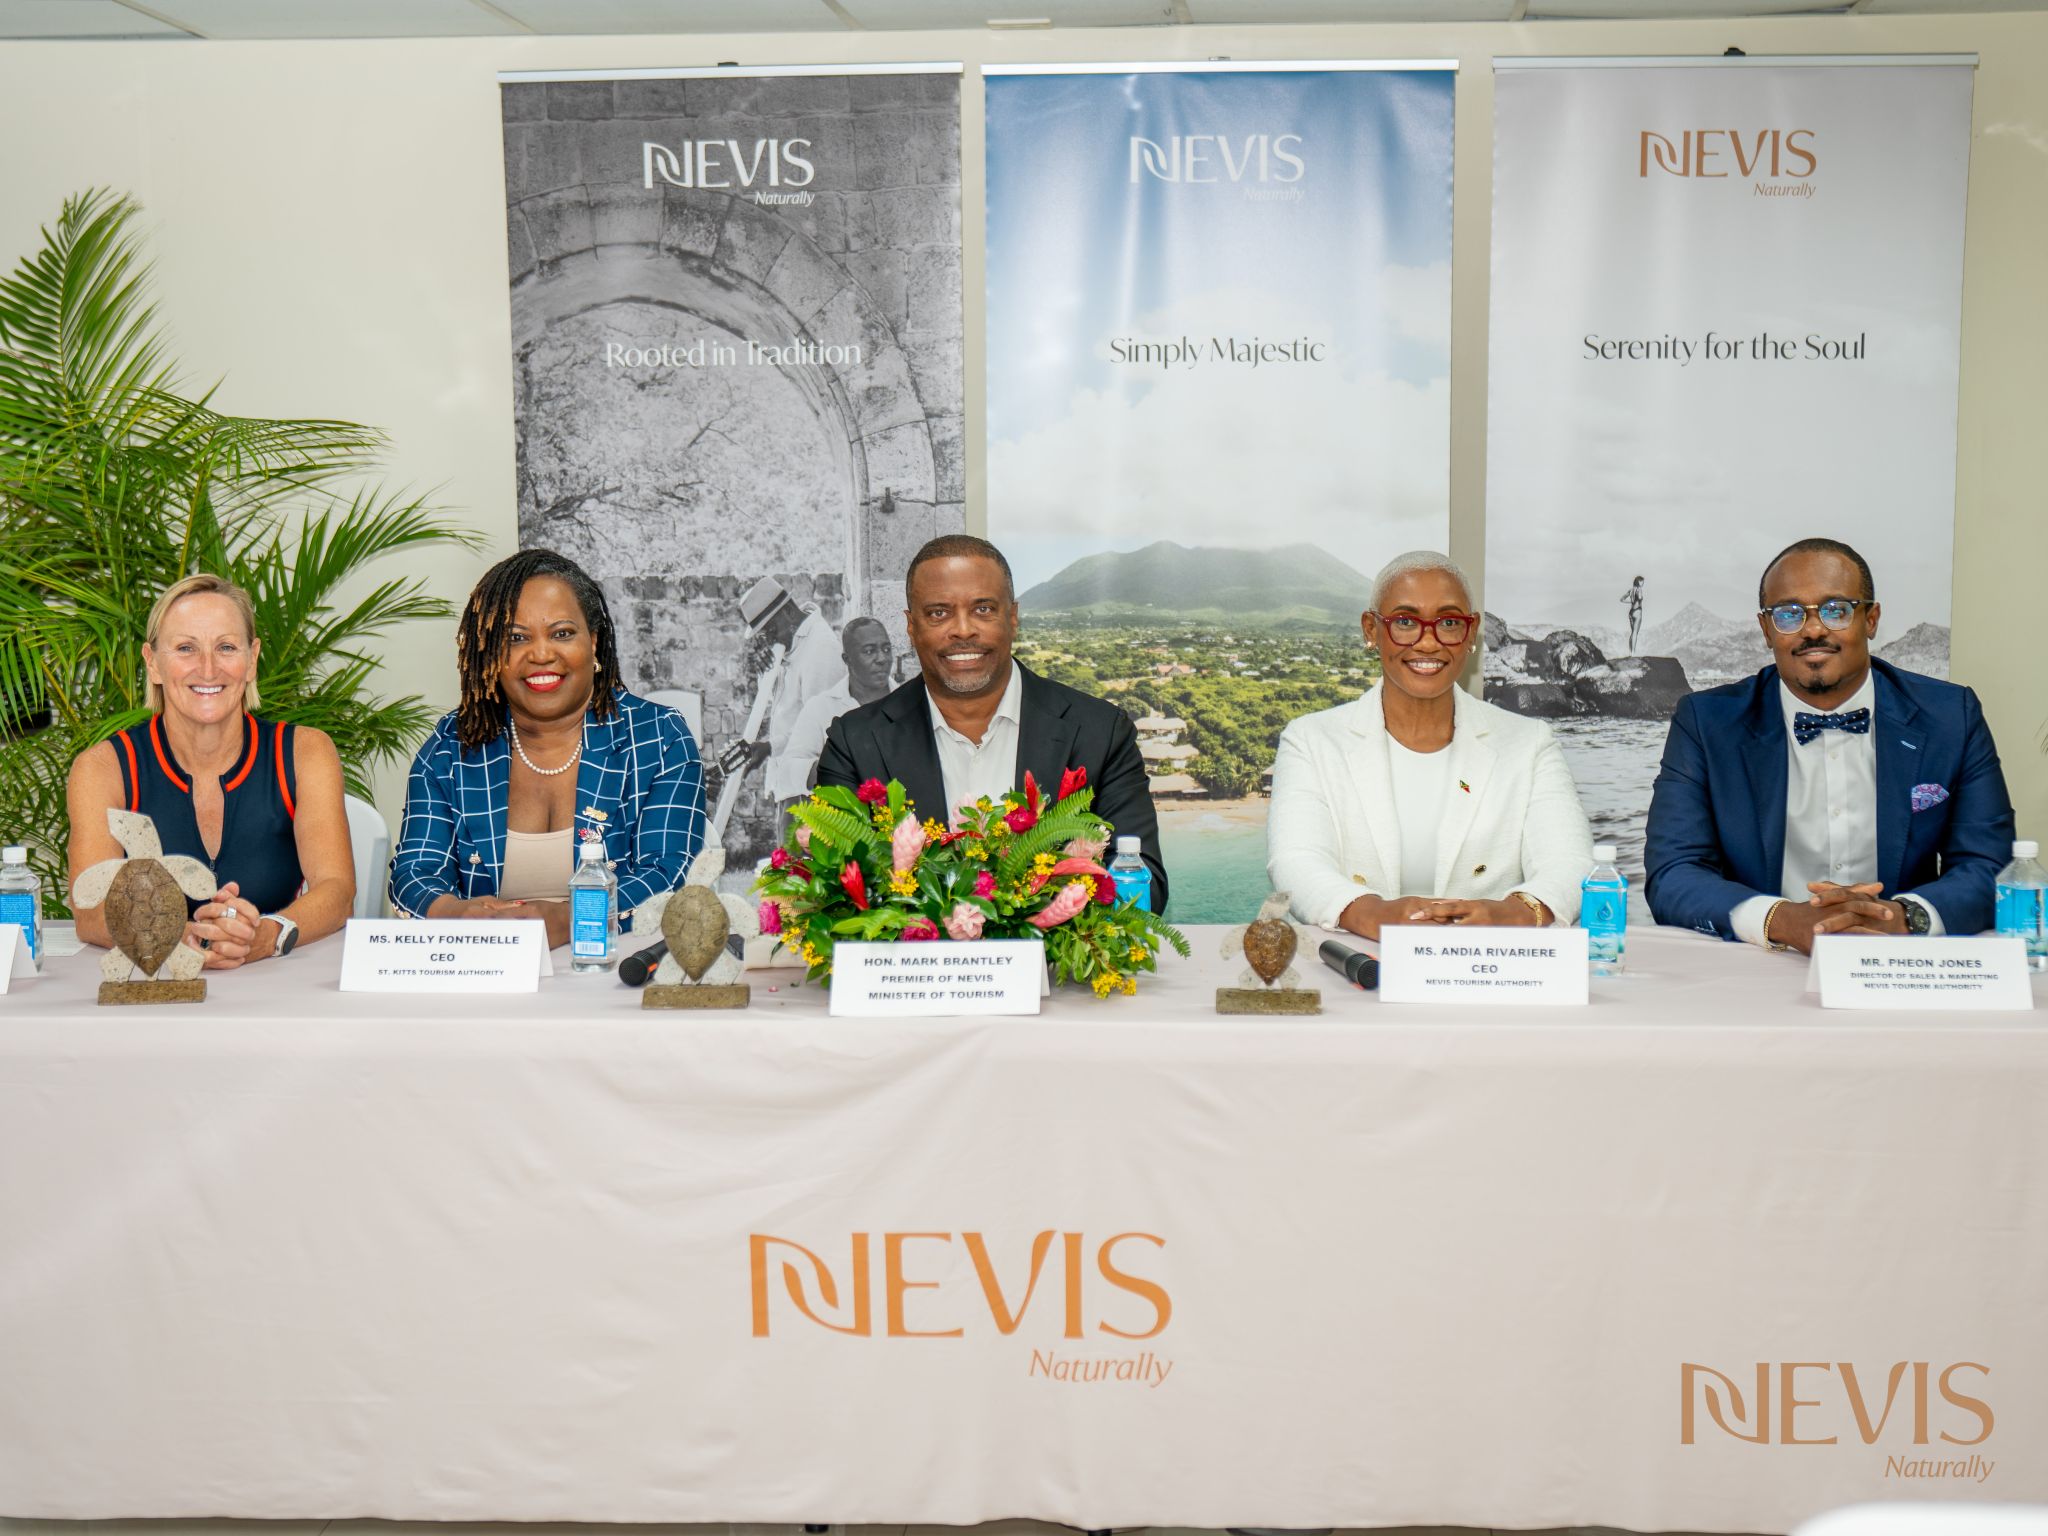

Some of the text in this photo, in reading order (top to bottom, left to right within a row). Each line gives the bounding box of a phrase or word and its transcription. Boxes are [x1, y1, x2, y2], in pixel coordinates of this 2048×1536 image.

[1130, 134, 1305, 184] NEVIS
[1639, 129, 1818, 179] NEVIS
[644, 138, 815, 190] NEVIS
[755, 189, 815, 208] Naturally
[1243, 185, 1305, 204] Naturally
[1753, 181, 1817, 200] Naturally
[605, 338, 862, 369] Rooted in Tradition
[1110, 335, 1326, 370] Simply Majestic
[1583, 331, 1866, 367] Serenity for the Soul
[369, 934, 520, 945] MS. KELLY FONTENELLE
[429, 952, 456, 963] CEO
[864, 956, 1014, 967] HON. MARK BRANTLEY
[1414, 946, 1557, 958] MS. ANDIA RIVARIERE
[1471, 964, 1499, 974] CEO
[1861, 958, 1983, 968] MR. PHEON JONES
[881, 974, 994, 984] PREMIER OF NEVIS
[1494, 979, 1544, 987] AUTHORITY
[868, 991, 1005, 1000] MINISTER OF TOURISM
[749, 1229, 1172, 1340] NEVIS
[1028, 1349, 1174, 1388] Naturally
[1680, 1360, 1995, 1446] NEVIS
[1884, 1454, 1995, 1484] Naturally
